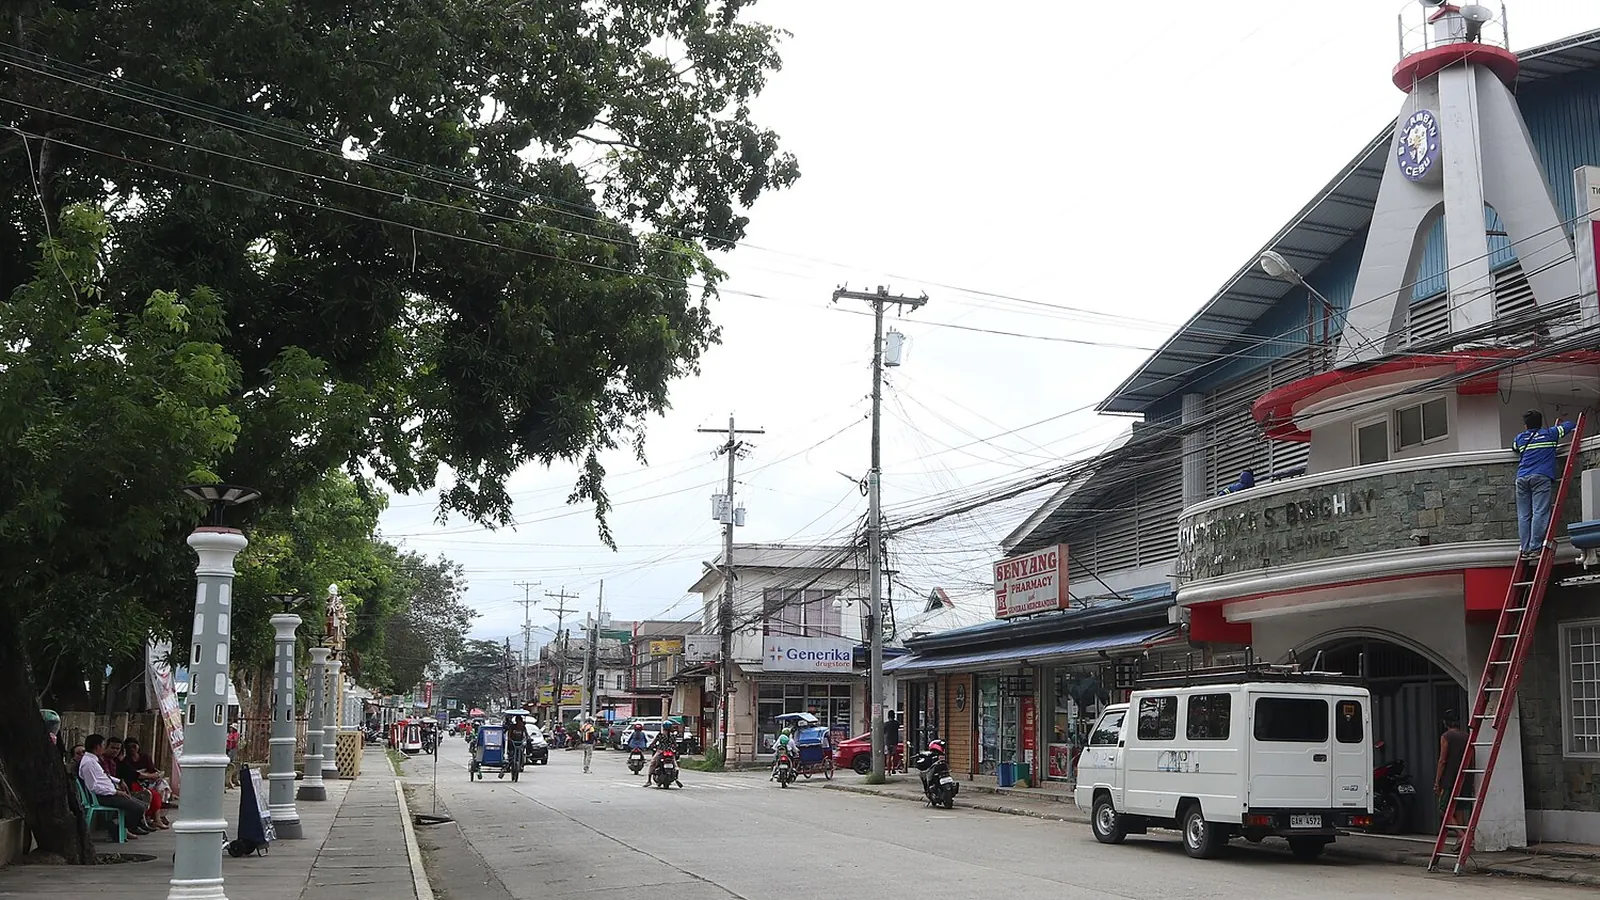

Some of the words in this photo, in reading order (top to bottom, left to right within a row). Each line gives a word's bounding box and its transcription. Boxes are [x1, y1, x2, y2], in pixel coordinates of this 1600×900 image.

[1398, 113, 1436, 155] BALAMBAN
[1405, 156, 1430, 176] CEBU
[997, 552, 1057, 582] SENYANG
[1012, 576, 1052, 593] PHARMACY
[1008, 603, 1027, 614] GENERAL
[786, 648, 850, 661] Generika
[815, 660, 850, 669] drugstore
